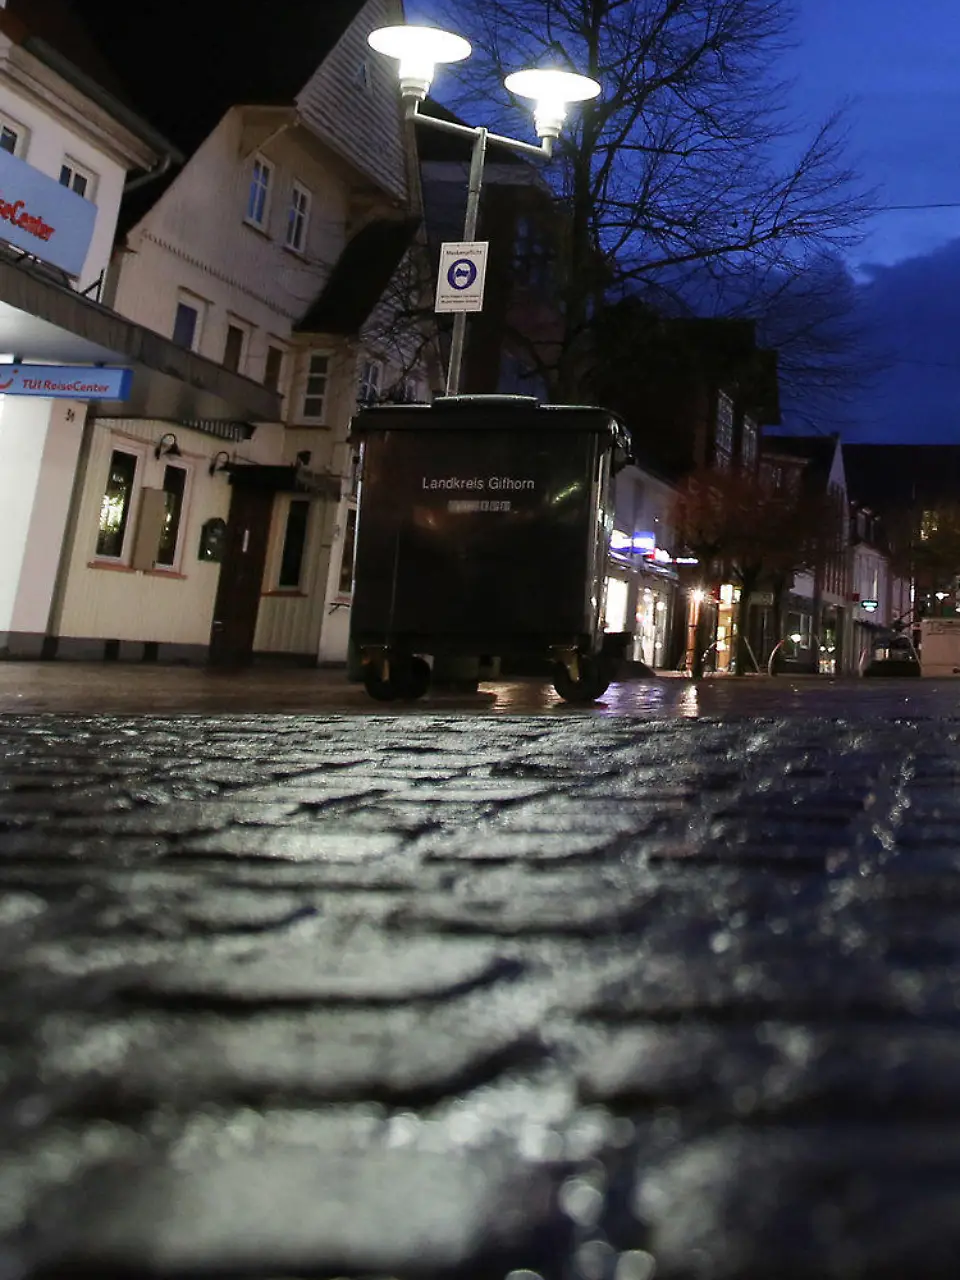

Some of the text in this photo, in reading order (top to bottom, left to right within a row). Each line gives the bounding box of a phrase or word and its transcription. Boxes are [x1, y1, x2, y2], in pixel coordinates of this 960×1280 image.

[23, 379, 110, 392] TUI ReiseCenter
[422, 477, 535, 489] Landkreis Gifhorn
